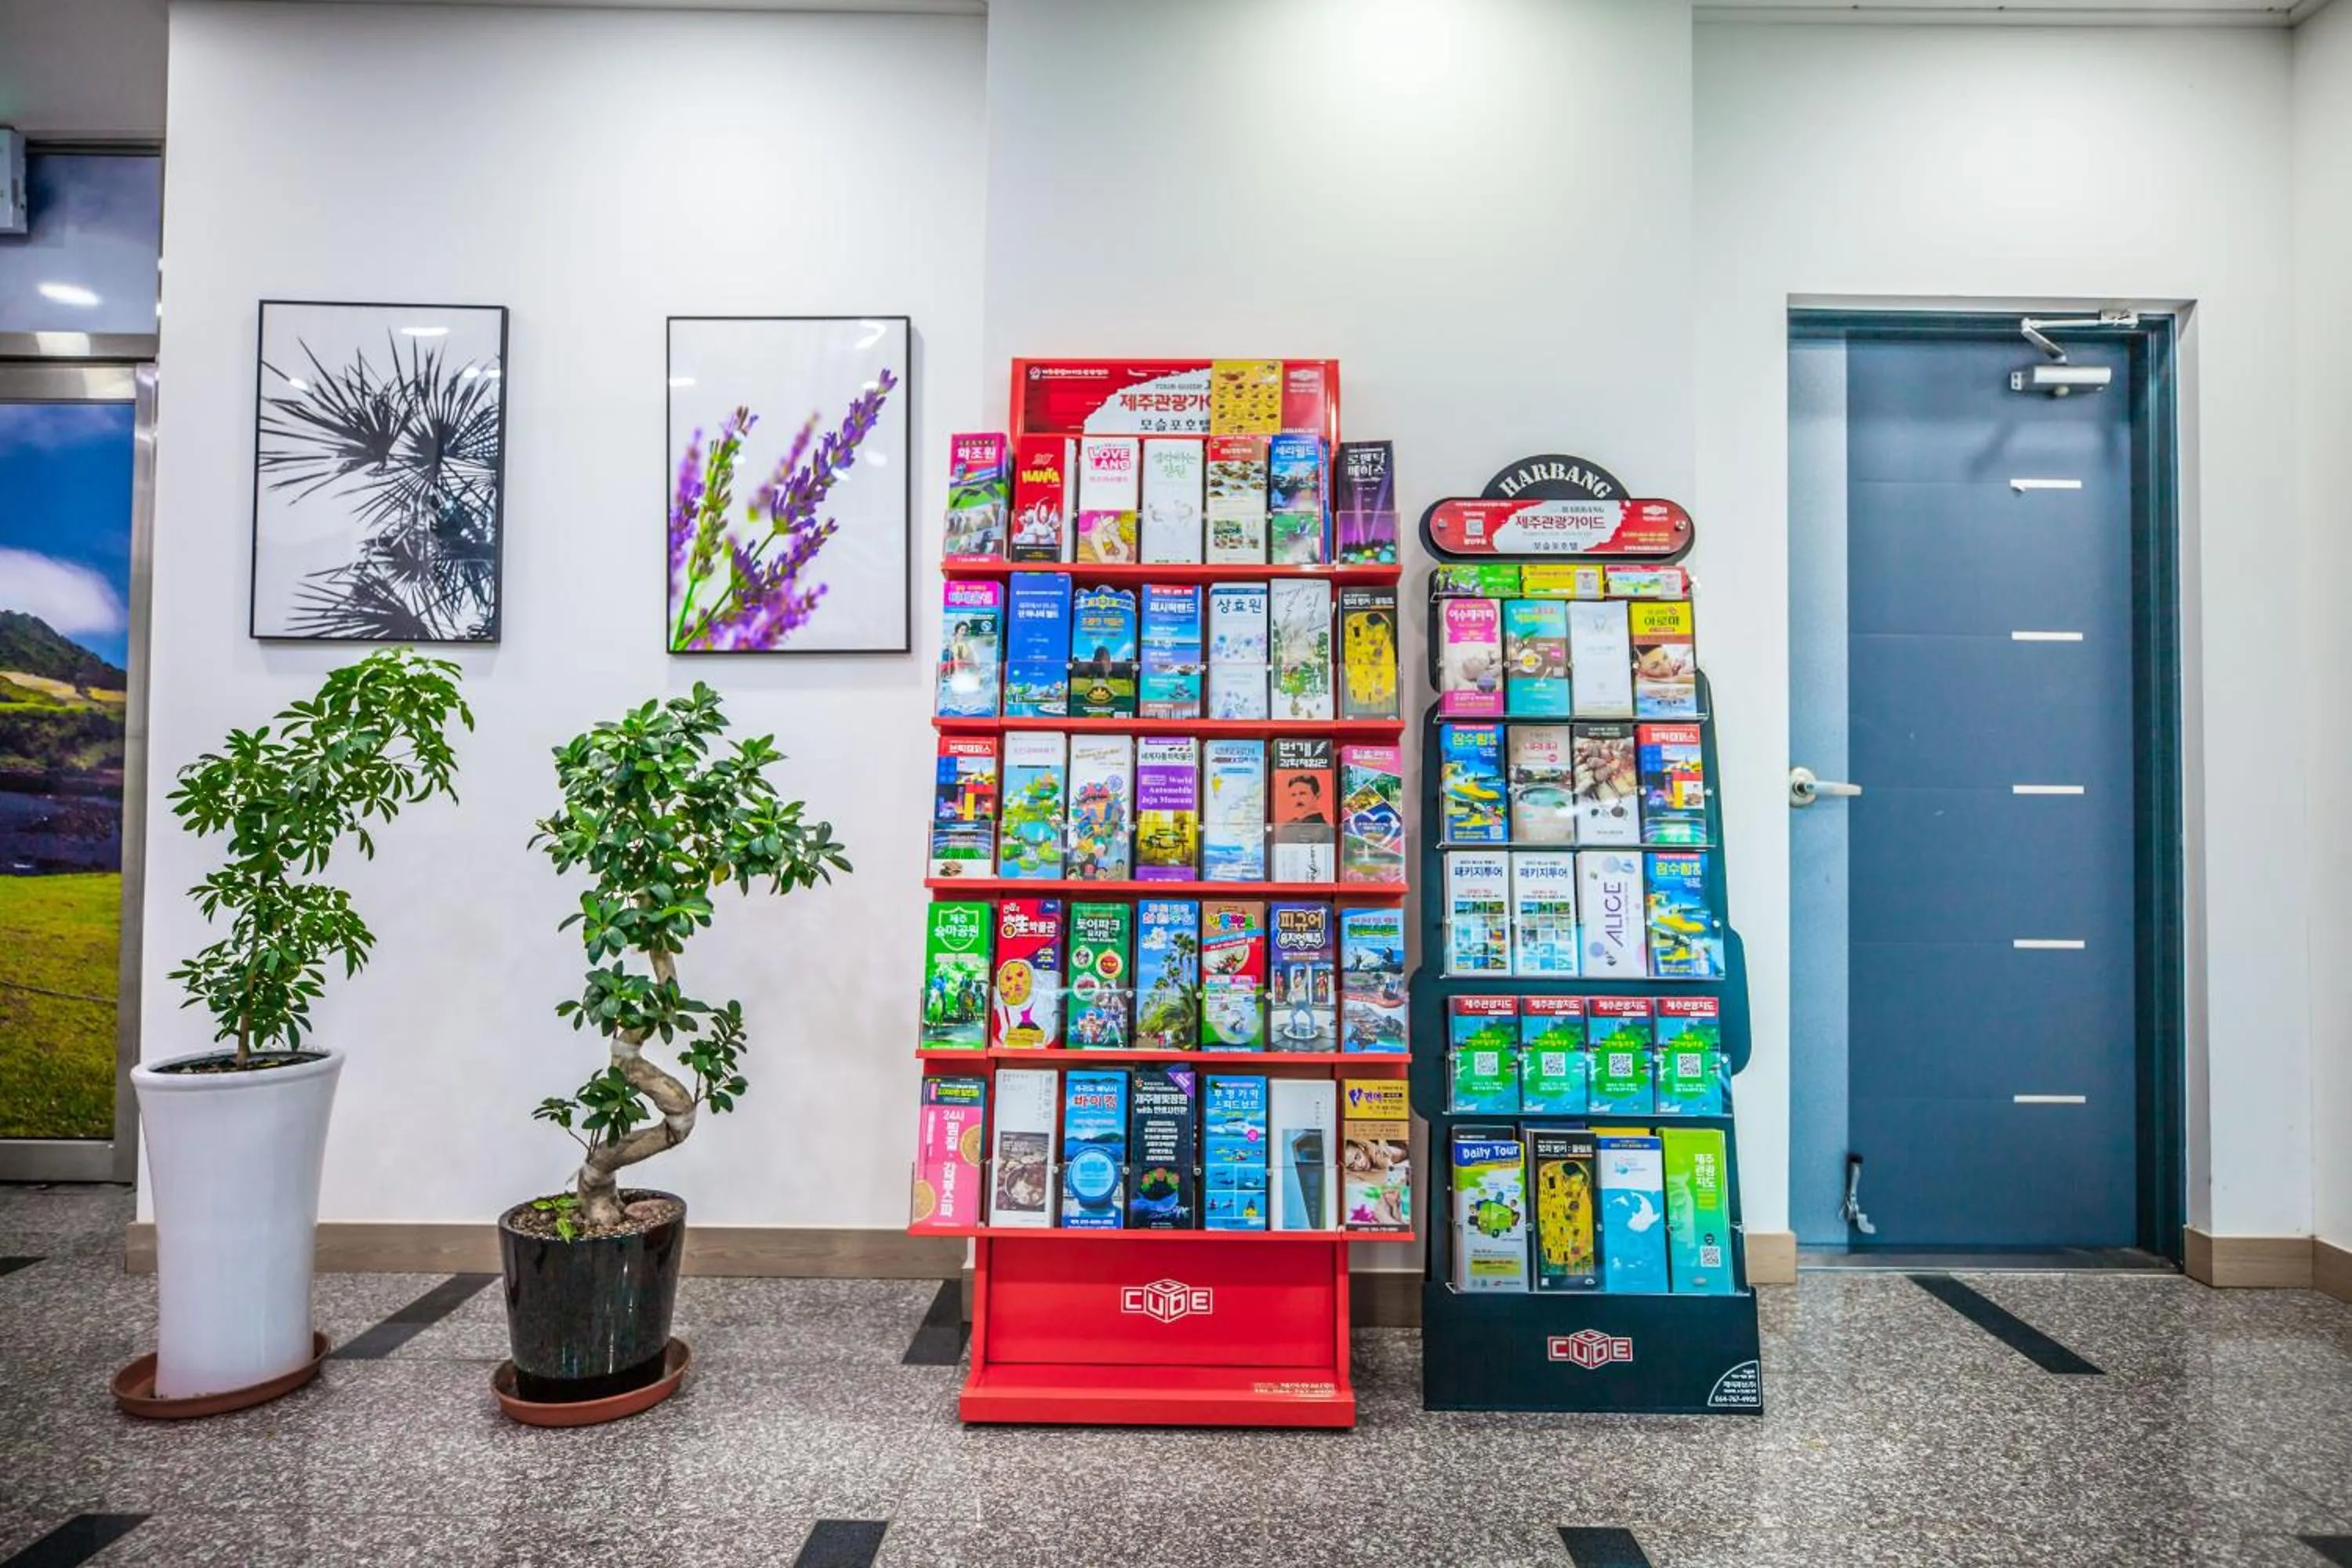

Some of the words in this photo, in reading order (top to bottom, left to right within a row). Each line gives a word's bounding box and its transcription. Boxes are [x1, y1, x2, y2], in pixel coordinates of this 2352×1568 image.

[1088, 447, 1130, 459] LOVE
[1091, 459, 1131, 470] LAND
[1499, 462, 1613, 499] HARBANG
[1515, 514, 1606, 530] 제주관광가이드
[1217, 598, 1261, 614] 상효원
[1279, 742, 1312, 758] 번개
[1142, 797, 1159, 805] Jeju
[1454, 866, 1504, 878] 패키지투어
[1519, 866, 1568, 878] 패키지투어
[1279, 912, 1322, 931] 피규어
[1604, 881, 1624, 948] ALICE
[1462, 1147, 1490, 1160] Daily
[1494, 1145, 1519, 1157] Tour
